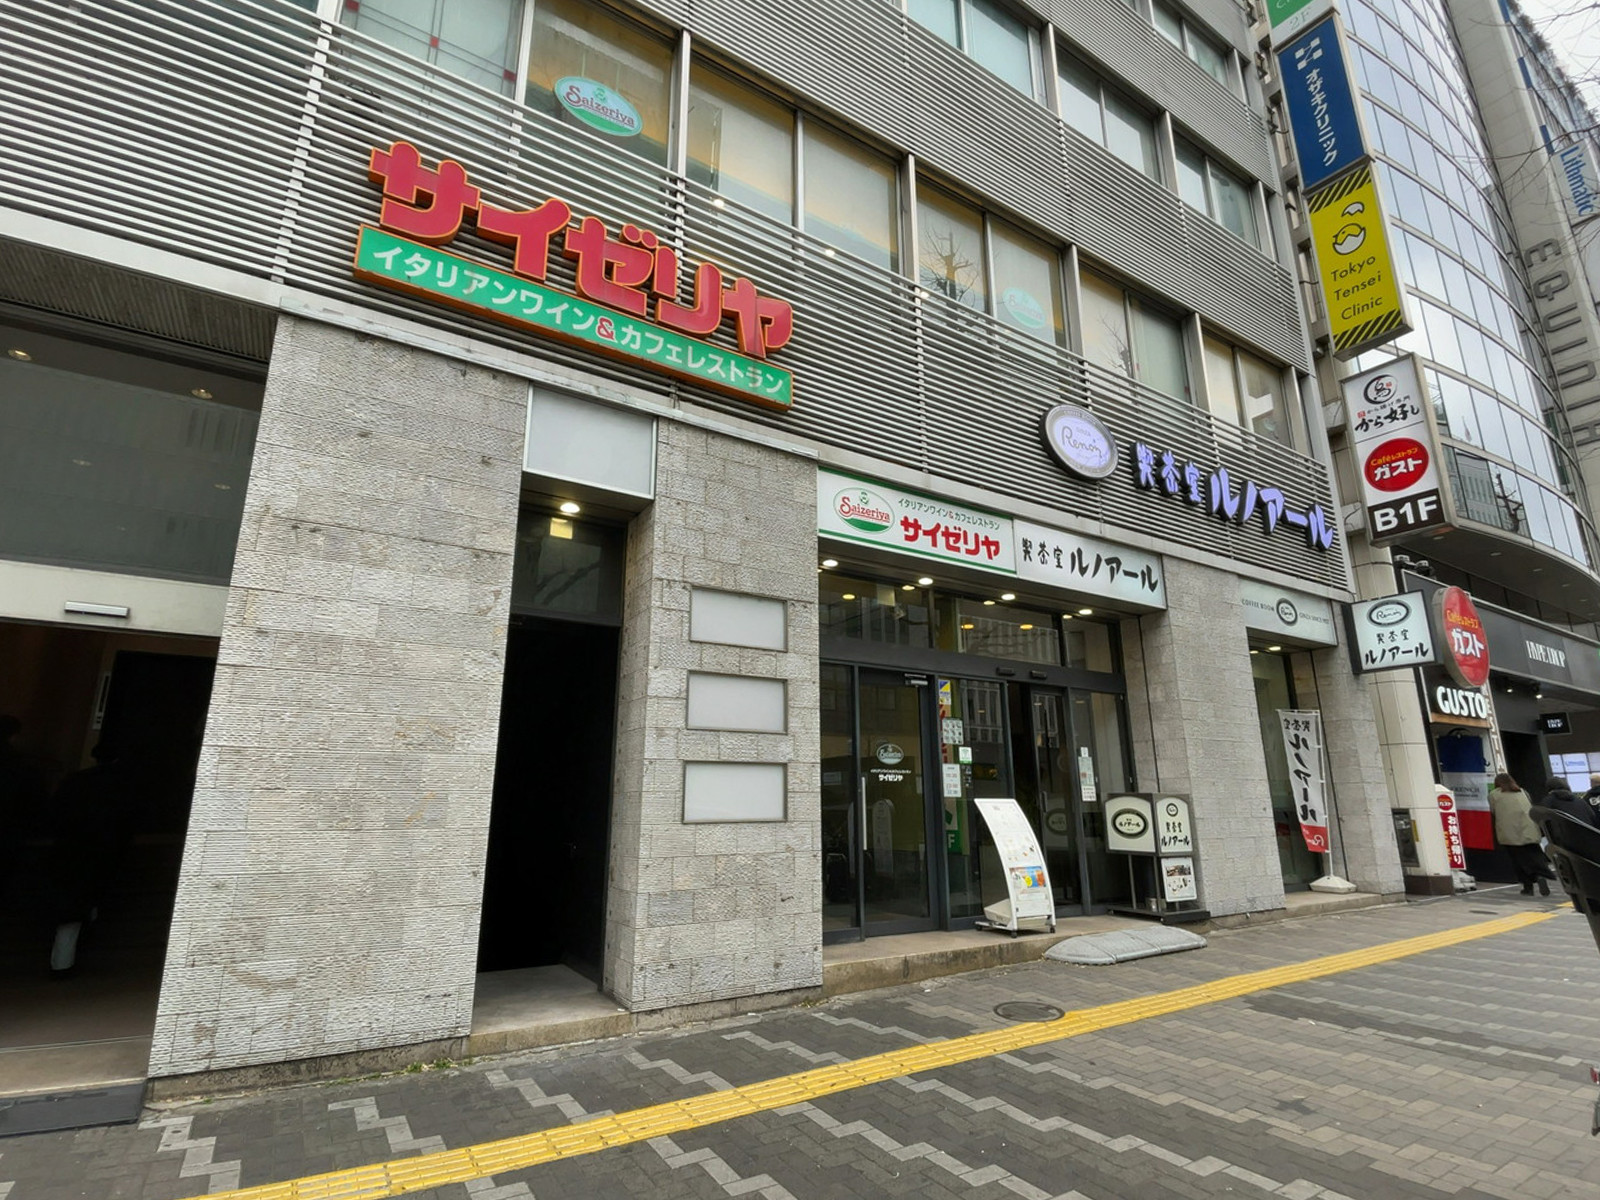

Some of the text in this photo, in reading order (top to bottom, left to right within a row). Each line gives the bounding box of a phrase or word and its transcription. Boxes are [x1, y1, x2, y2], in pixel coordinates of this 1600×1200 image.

[563, 85, 635, 128] Saizeriya
[1306, 68, 1337, 167] オザキクリニック
[1560, 145, 1598, 217] Lithmatic
[369, 141, 793, 359] サイゼリヤ
[1331, 255, 1376, 282] Tokyo
[1334, 273, 1382, 301] Tensei
[1341, 297, 1383, 321] Clinic
[1355, 404, 1420, 432] から好し
[1374, 458, 1422, 481] ガスト
[839, 496, 891, 523] Saizeriya
[1135, 441, 1334, 550] 喫茶室 ルノアール
[1374, 495, 1437, 532] B1F
[900, 515, 1001, 560] サイゼリヤ
[1022, 537, 1159, 593] 喫茶室 ルノアール
[1365, 642, 1429, 665] ルノアール
[1451, 627, 1485, 659] ガスト
[1436, 685, 1489, 719] GUSTO
